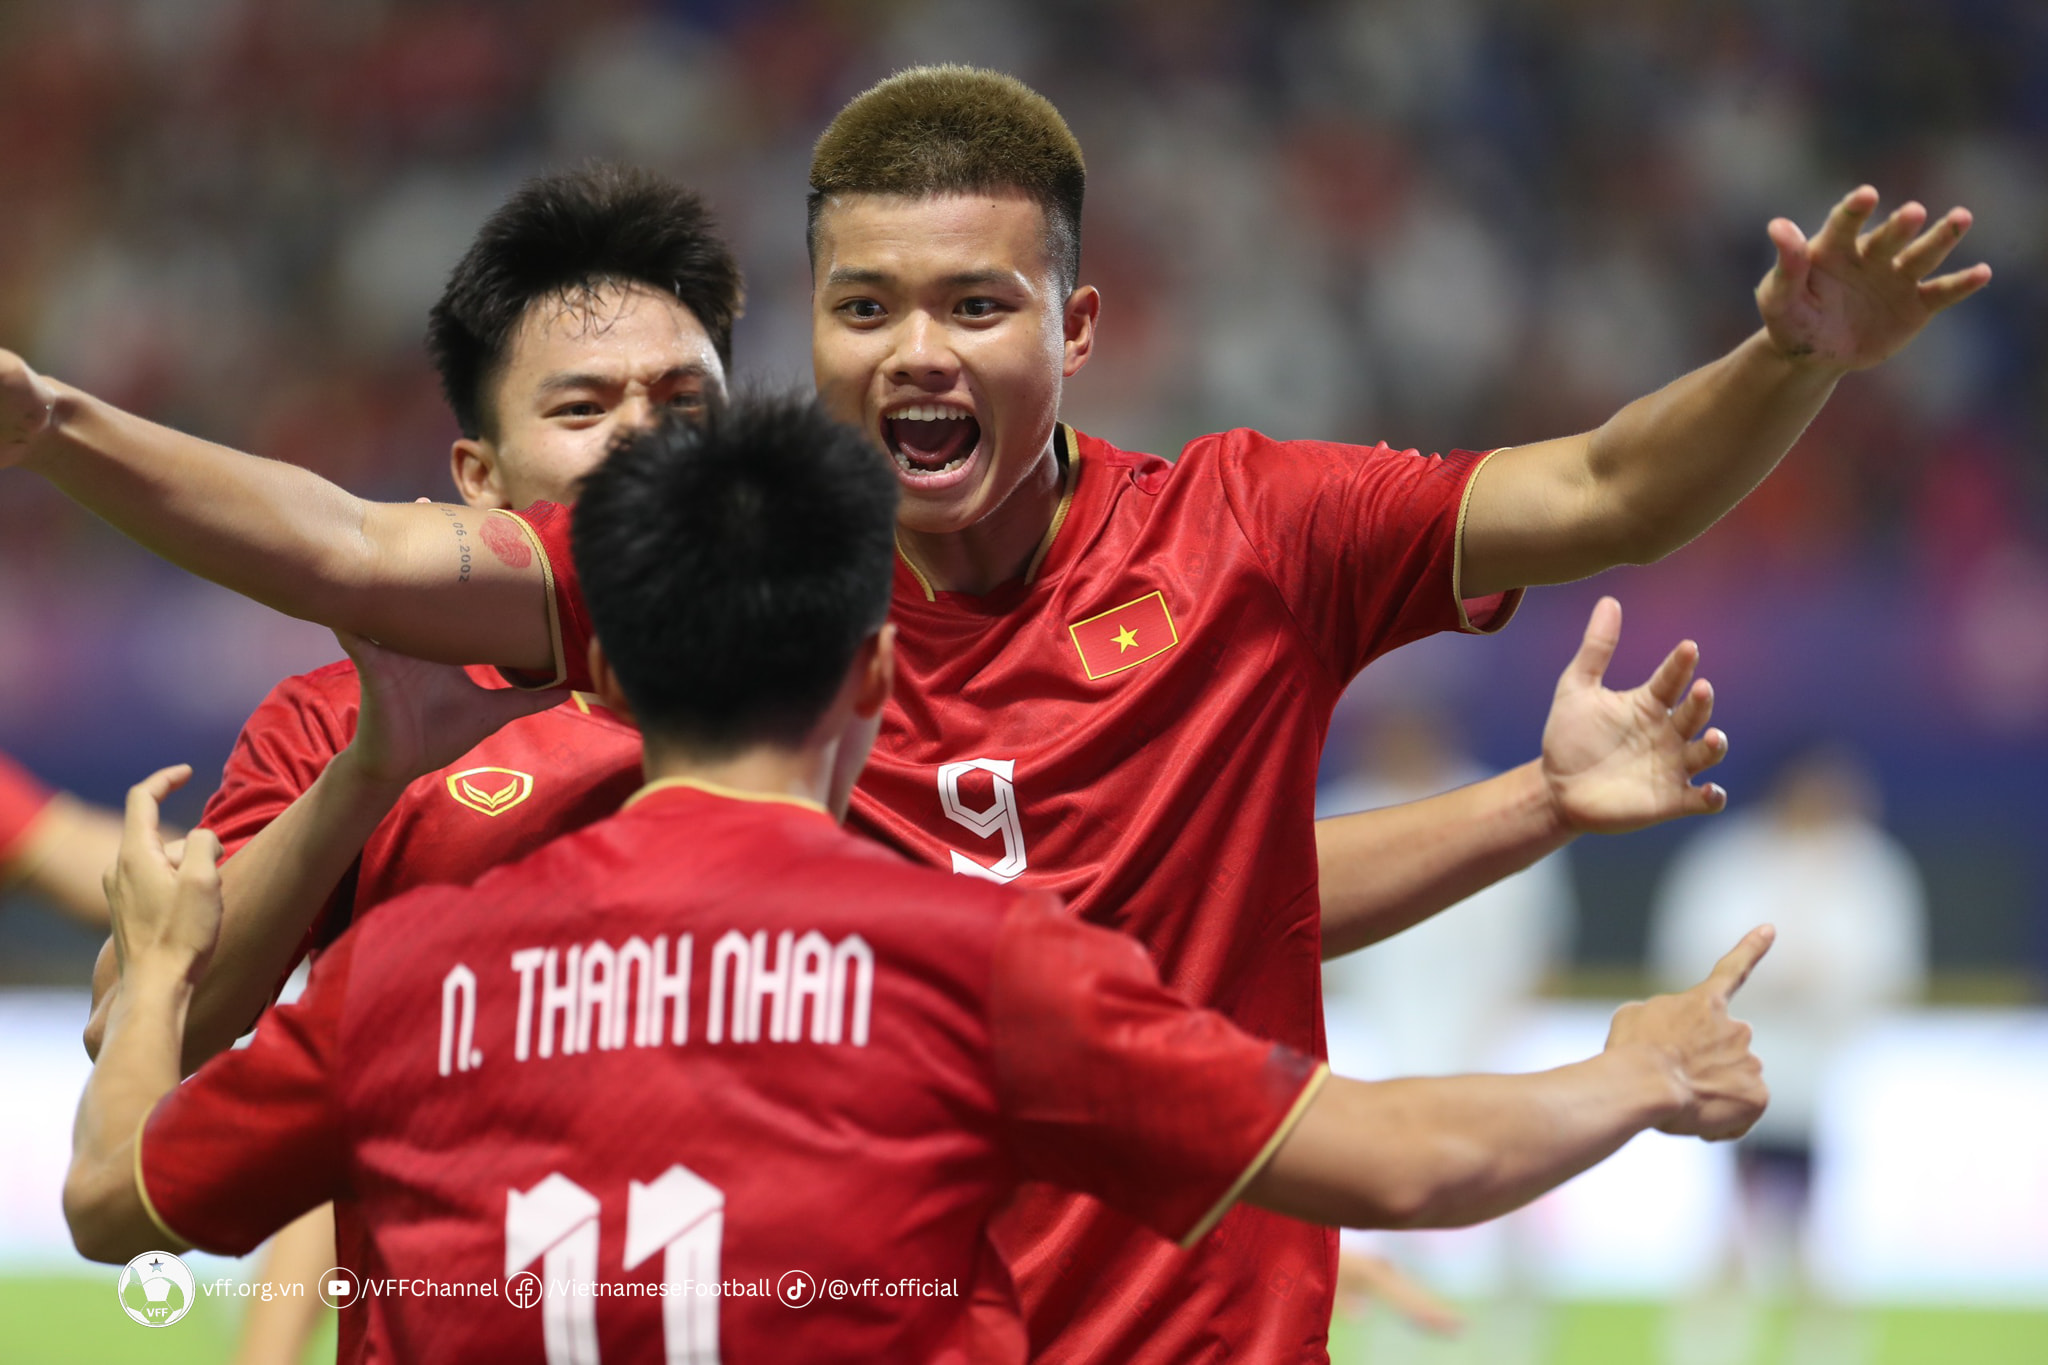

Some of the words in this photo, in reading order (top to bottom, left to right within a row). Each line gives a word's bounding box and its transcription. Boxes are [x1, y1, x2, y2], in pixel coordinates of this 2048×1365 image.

[937, 757, 1028, 885] 9
[438, 963, 483, 1076] N.
[511, 932, 693, 1062] THANH
[706, 928, 874, 1047] NHAN
[505, 1163, 726, 1365] 11
